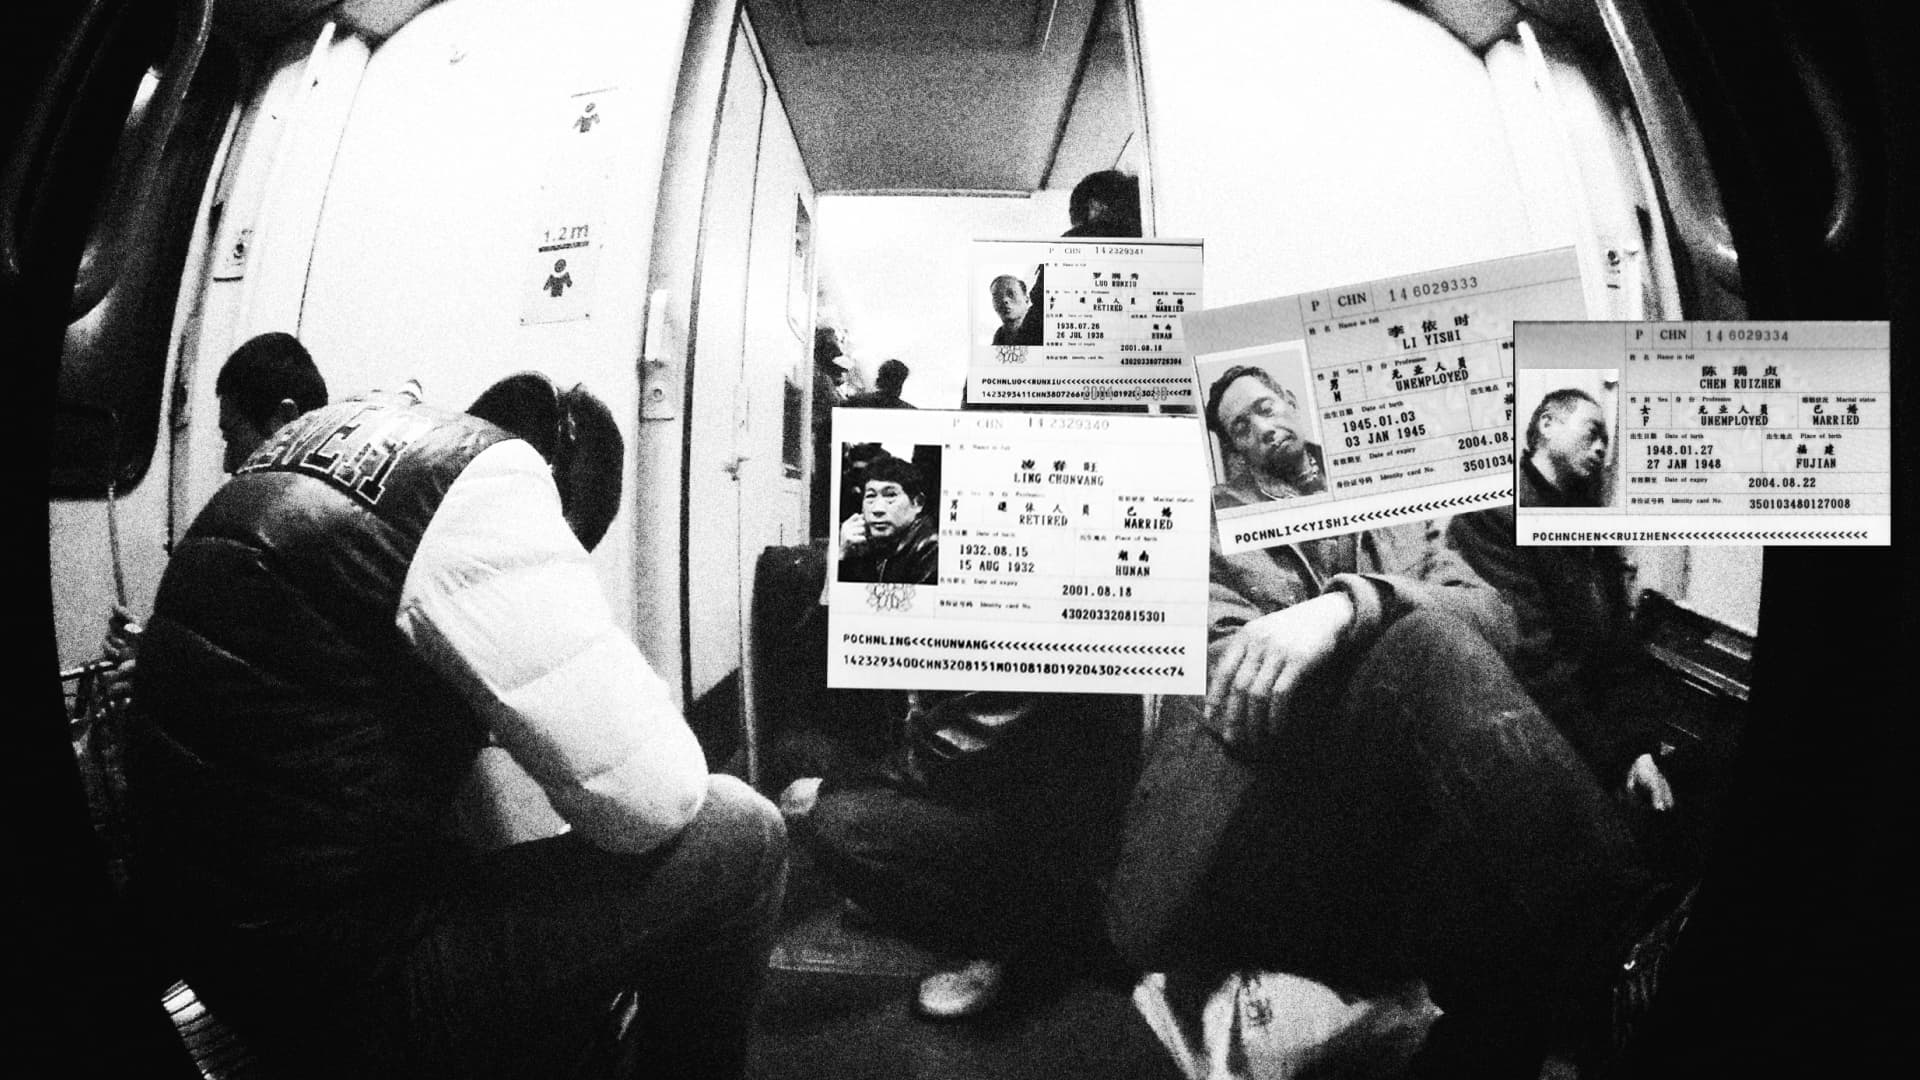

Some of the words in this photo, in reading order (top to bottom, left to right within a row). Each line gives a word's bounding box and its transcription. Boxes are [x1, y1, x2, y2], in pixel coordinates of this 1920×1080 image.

[544, 224, 589, 242] 1.2m
[1311, 300, 1320, 312] P
[1337, 292, 1367, 308] CHN
[1412, 276, 1478, 298] 6029333
[1093, 304, 1123, 312] RETIRED
[1056, 322, 1100, 330] 1938.07.26
[1069, 331, 1083, 339] JUL
[1087, 331, 1105, 339] 1938
[1402, 336, 1417, 350] LI
[1424, 329, 1462, 346] YISHI
[1635, 329, 1643, 340] P
[1660, 329, 1687, 340] CHN
[1729, 330, 1789, 342] 6029334
[1395, 368, 1469, 392] UNEMPLOYED
[1699, 378, 1727, 390] CHEN
[1734, 378, 1781, 390] RUIZHEN
[1333, 390, 1342, 402] M
[1640, 404, 1651, 415] 女
[1342, 410, 1416, 433] 1945.01.03
[1643, 415, 1650, 427] F
[1700, 415, 1769, 426] UNEMPLOYED
[1812, 415, 1860, 426] MARRIED
[1345, 435, 1361, 449] 03
[1367, 429, 1390, 445] JAN
[1397, 424, 1427, 440] 1945
[1646, 445, 1714, 456] 1948.01.27
[1647, 459, 1660, 470] 27
[1667, 459, 1687, 470] JAN
[1695, 459, 1722, 470] 1948
[1796, 458, 1837, 469] FUJIAN
[1013, 472, 1042, 484] LING
[1047, 473, 1104, 487] CHUNWANG
[1748, 477, 1817, 488] 2004.08.22
[1749, 498, 1851, 510] 350103480127008
[1018, 514, 1068, 528] RETIRED
[1123, 517, 1174, 530] MARRIED
[959, 544, 1029, 558] 1932.08.15
[958, 559, 973, 571] 15
[979, 560, 1000, 573] AUG
[1006, 561, 1036, 574] 1932
[1115, 564, 1150, 577] HUNAN
[1061, 585, 1133, 598] 2001.08.18
[1061, 608, 1166, 623] 430203320815301
